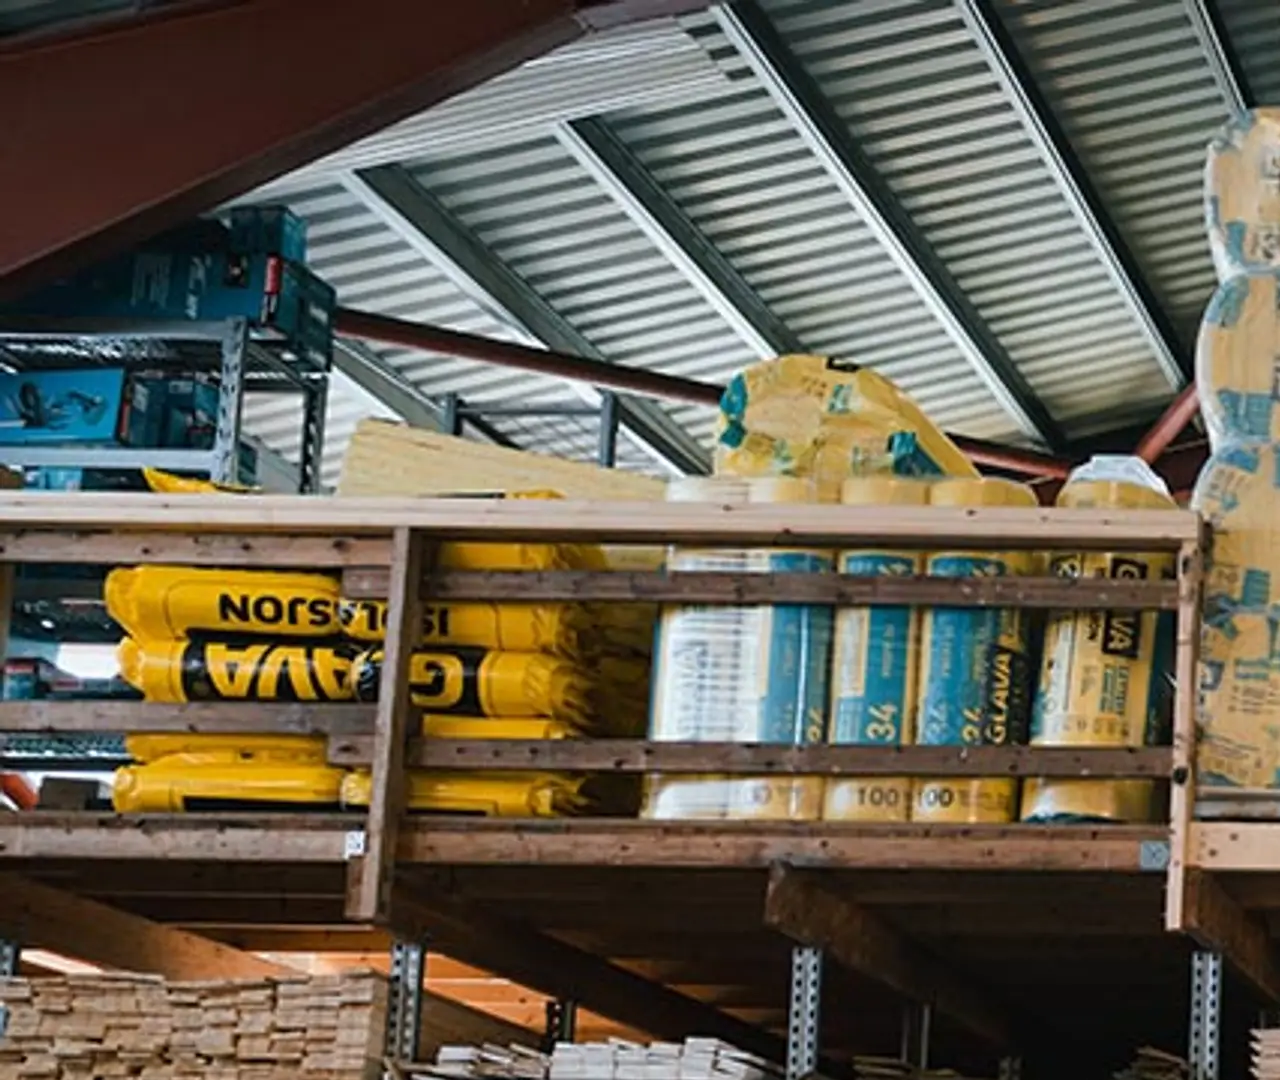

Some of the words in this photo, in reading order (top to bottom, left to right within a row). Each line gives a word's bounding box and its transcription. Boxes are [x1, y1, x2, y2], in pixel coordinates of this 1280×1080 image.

[218, 593, 450, 638] ISLASJON
[204, 642, 464, 707] GAVA
[985, 652, 1012, 744] GLAVA
[867, 703, 898, 742] 34
